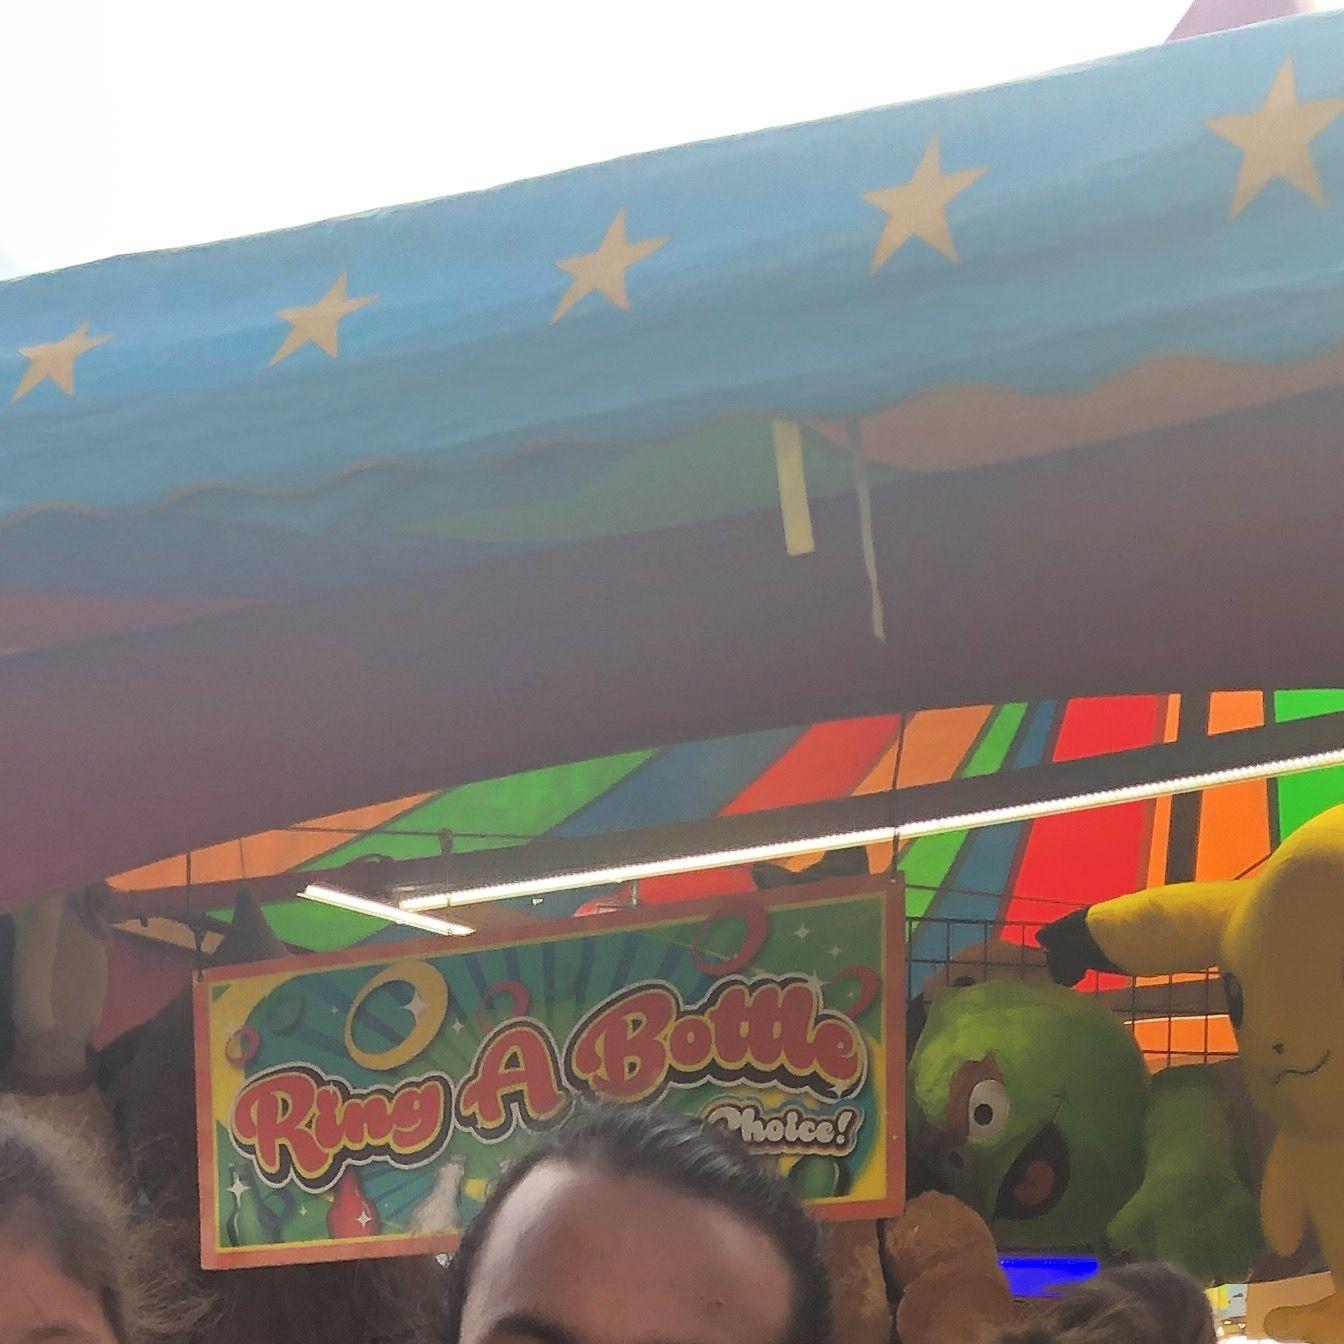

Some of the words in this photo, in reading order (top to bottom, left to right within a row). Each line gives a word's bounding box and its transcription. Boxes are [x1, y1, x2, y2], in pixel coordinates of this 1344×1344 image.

[232, 1069, 446, 1181] Ring
[459, 1022, 565, 1129] A
[569, 983, 860, 1104] Bottle
